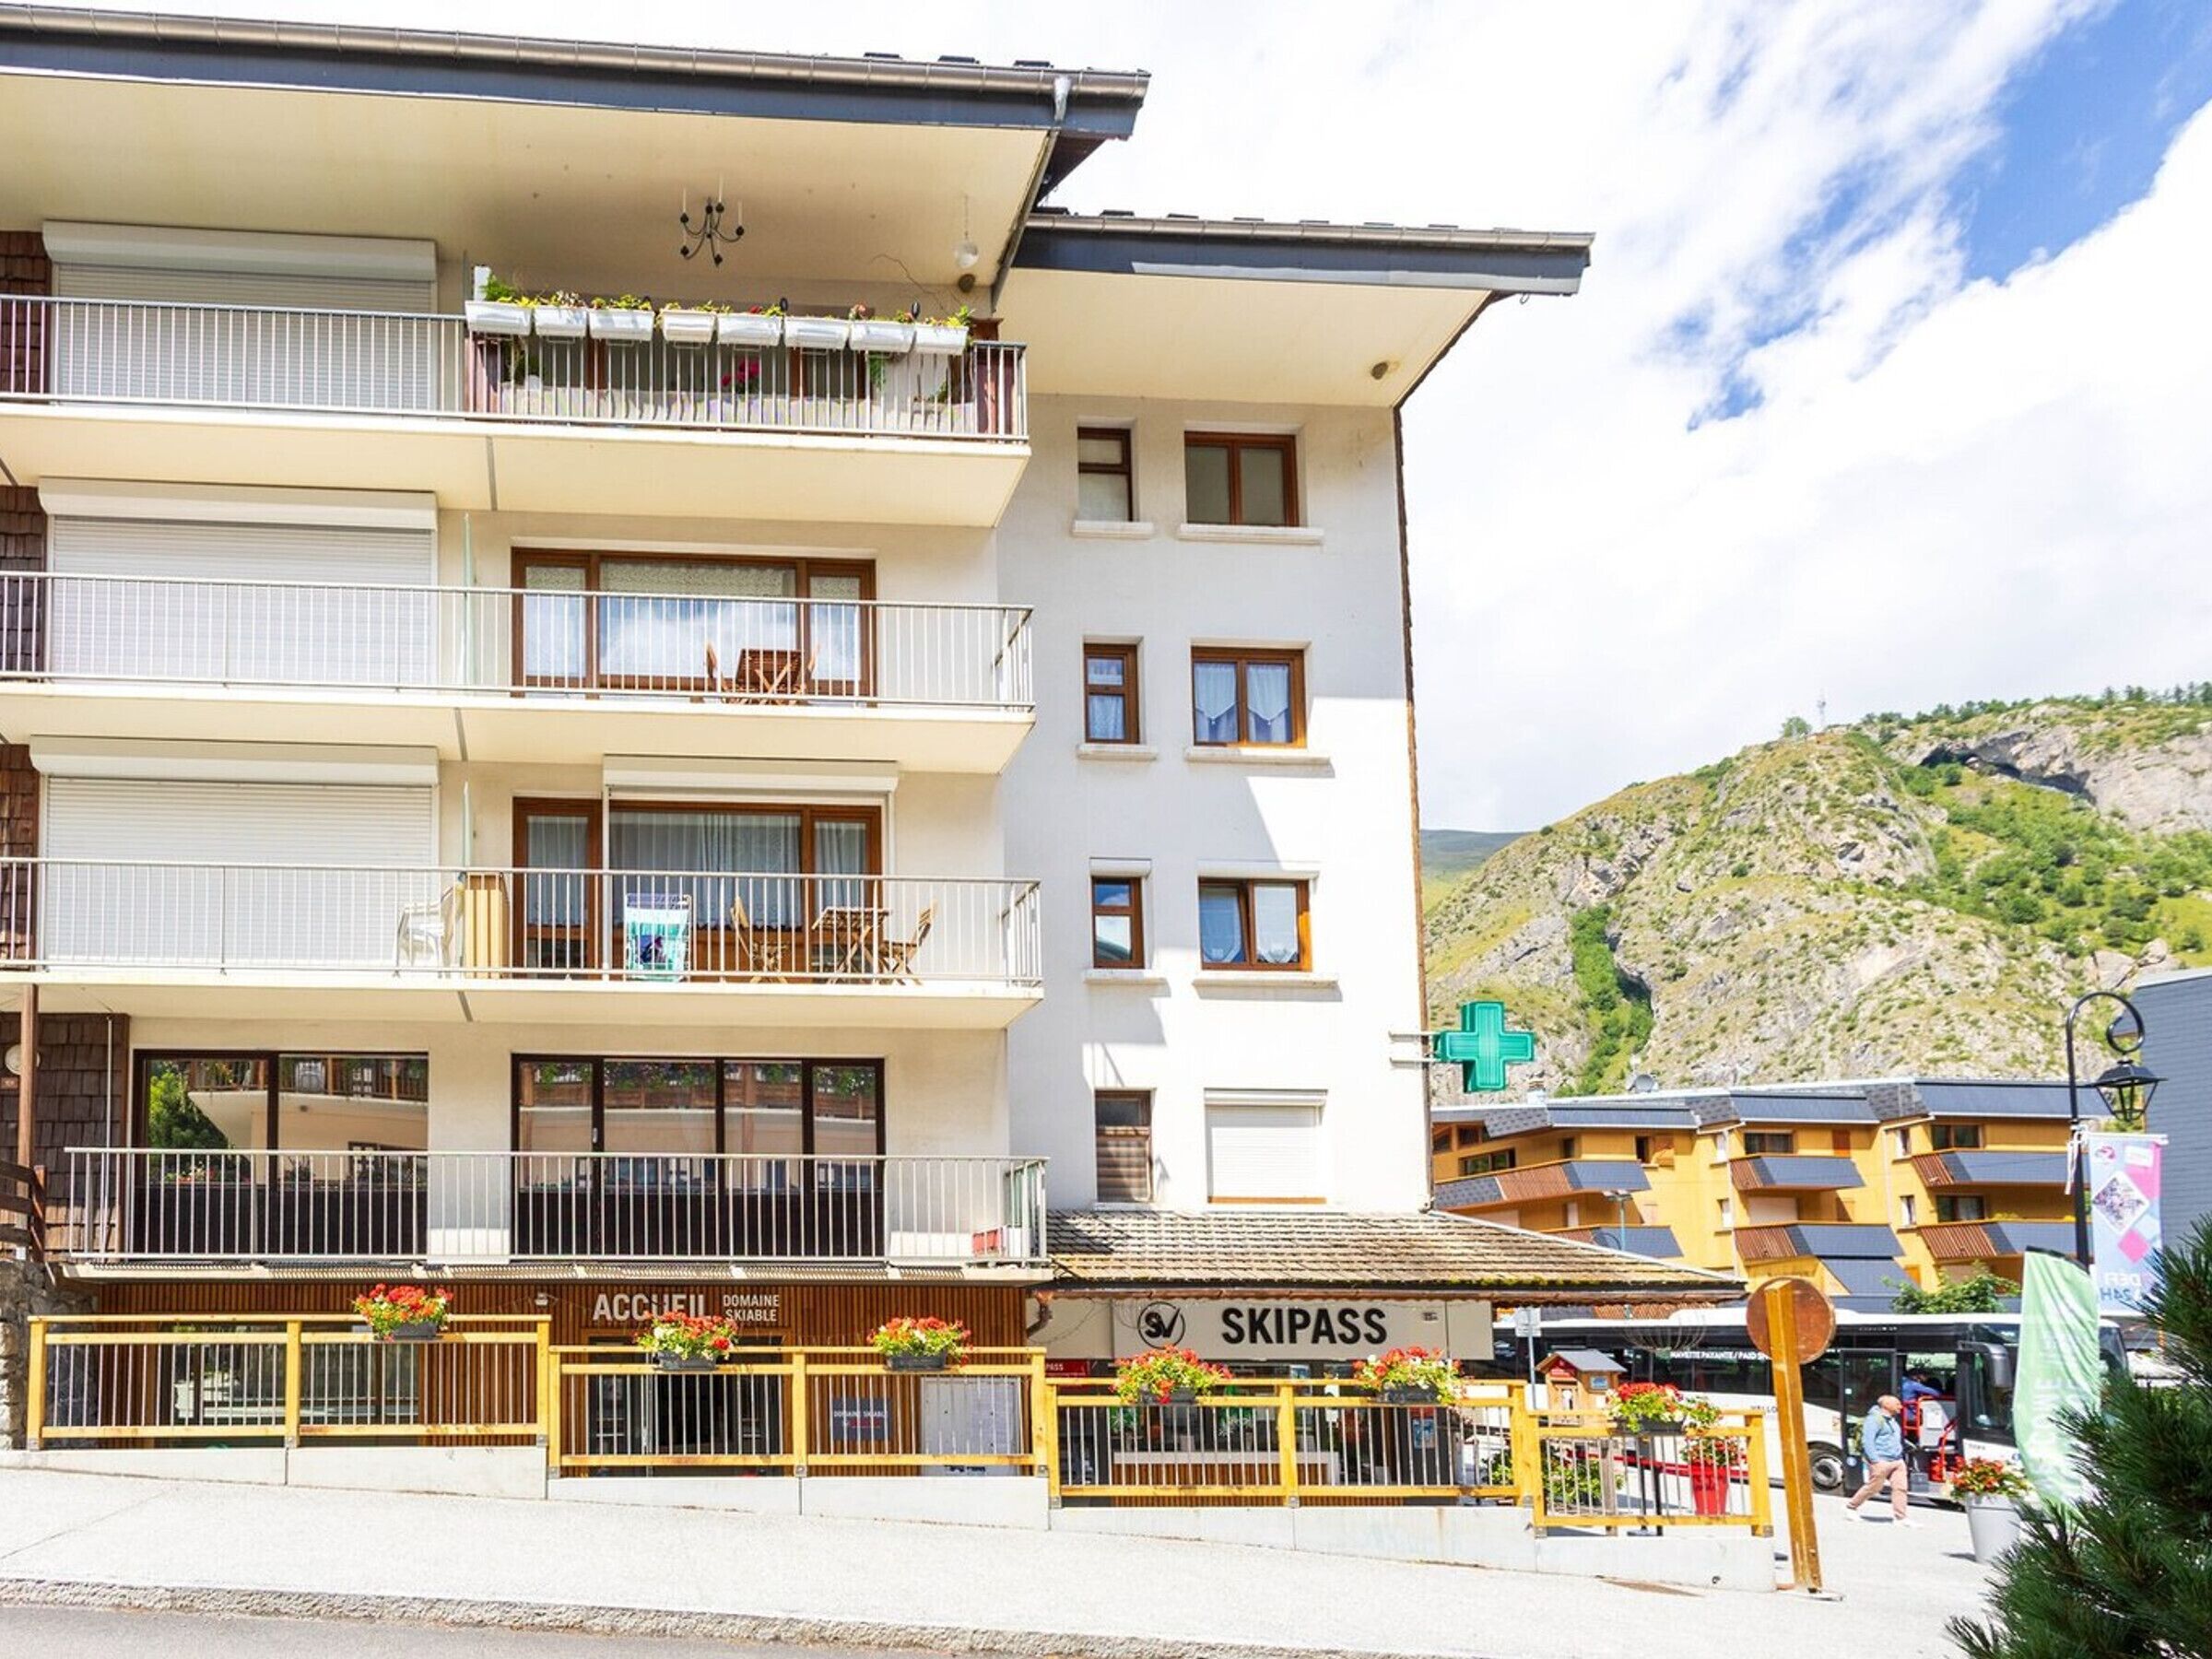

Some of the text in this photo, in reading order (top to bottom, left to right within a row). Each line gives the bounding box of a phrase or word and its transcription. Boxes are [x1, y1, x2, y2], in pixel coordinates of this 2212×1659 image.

[722, 1294, 780, 1307] DOMAINE
[724, 1309, 777, 1322] SKIABLE
[1221, 1307, 1387, 1345] SKIPASS
[1670, 1350, 1700, 1359] NAVETTE
[1702, 1350, 1733, 1359] PAYANTE
[1738, 1351, 1757, 1360] PAID
